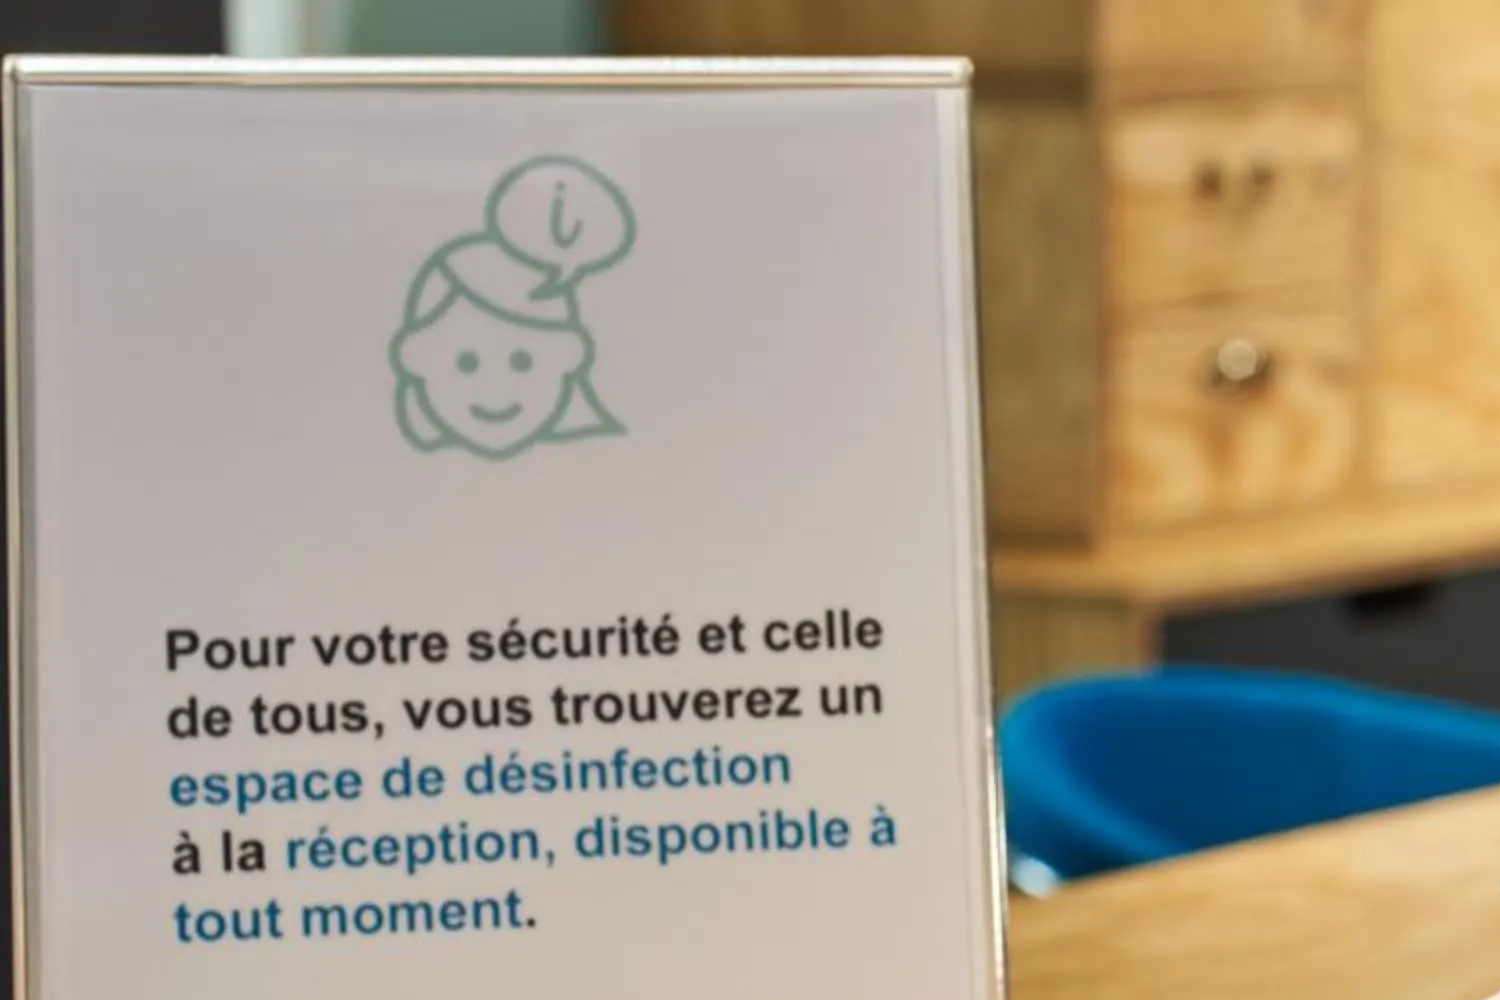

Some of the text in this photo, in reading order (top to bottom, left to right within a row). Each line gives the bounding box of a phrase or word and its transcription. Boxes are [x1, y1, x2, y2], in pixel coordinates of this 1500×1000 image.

[165, 608, 883, 672] Pour votre sécurité et celle
[167, 683, 883, 740] de tous, vous trouverez un
[170, 746, 790, 815] espace de désinfection
[172, 805, 896, 875] à la réception, disponible à
[174, 890, 536, 944] tout moment.
